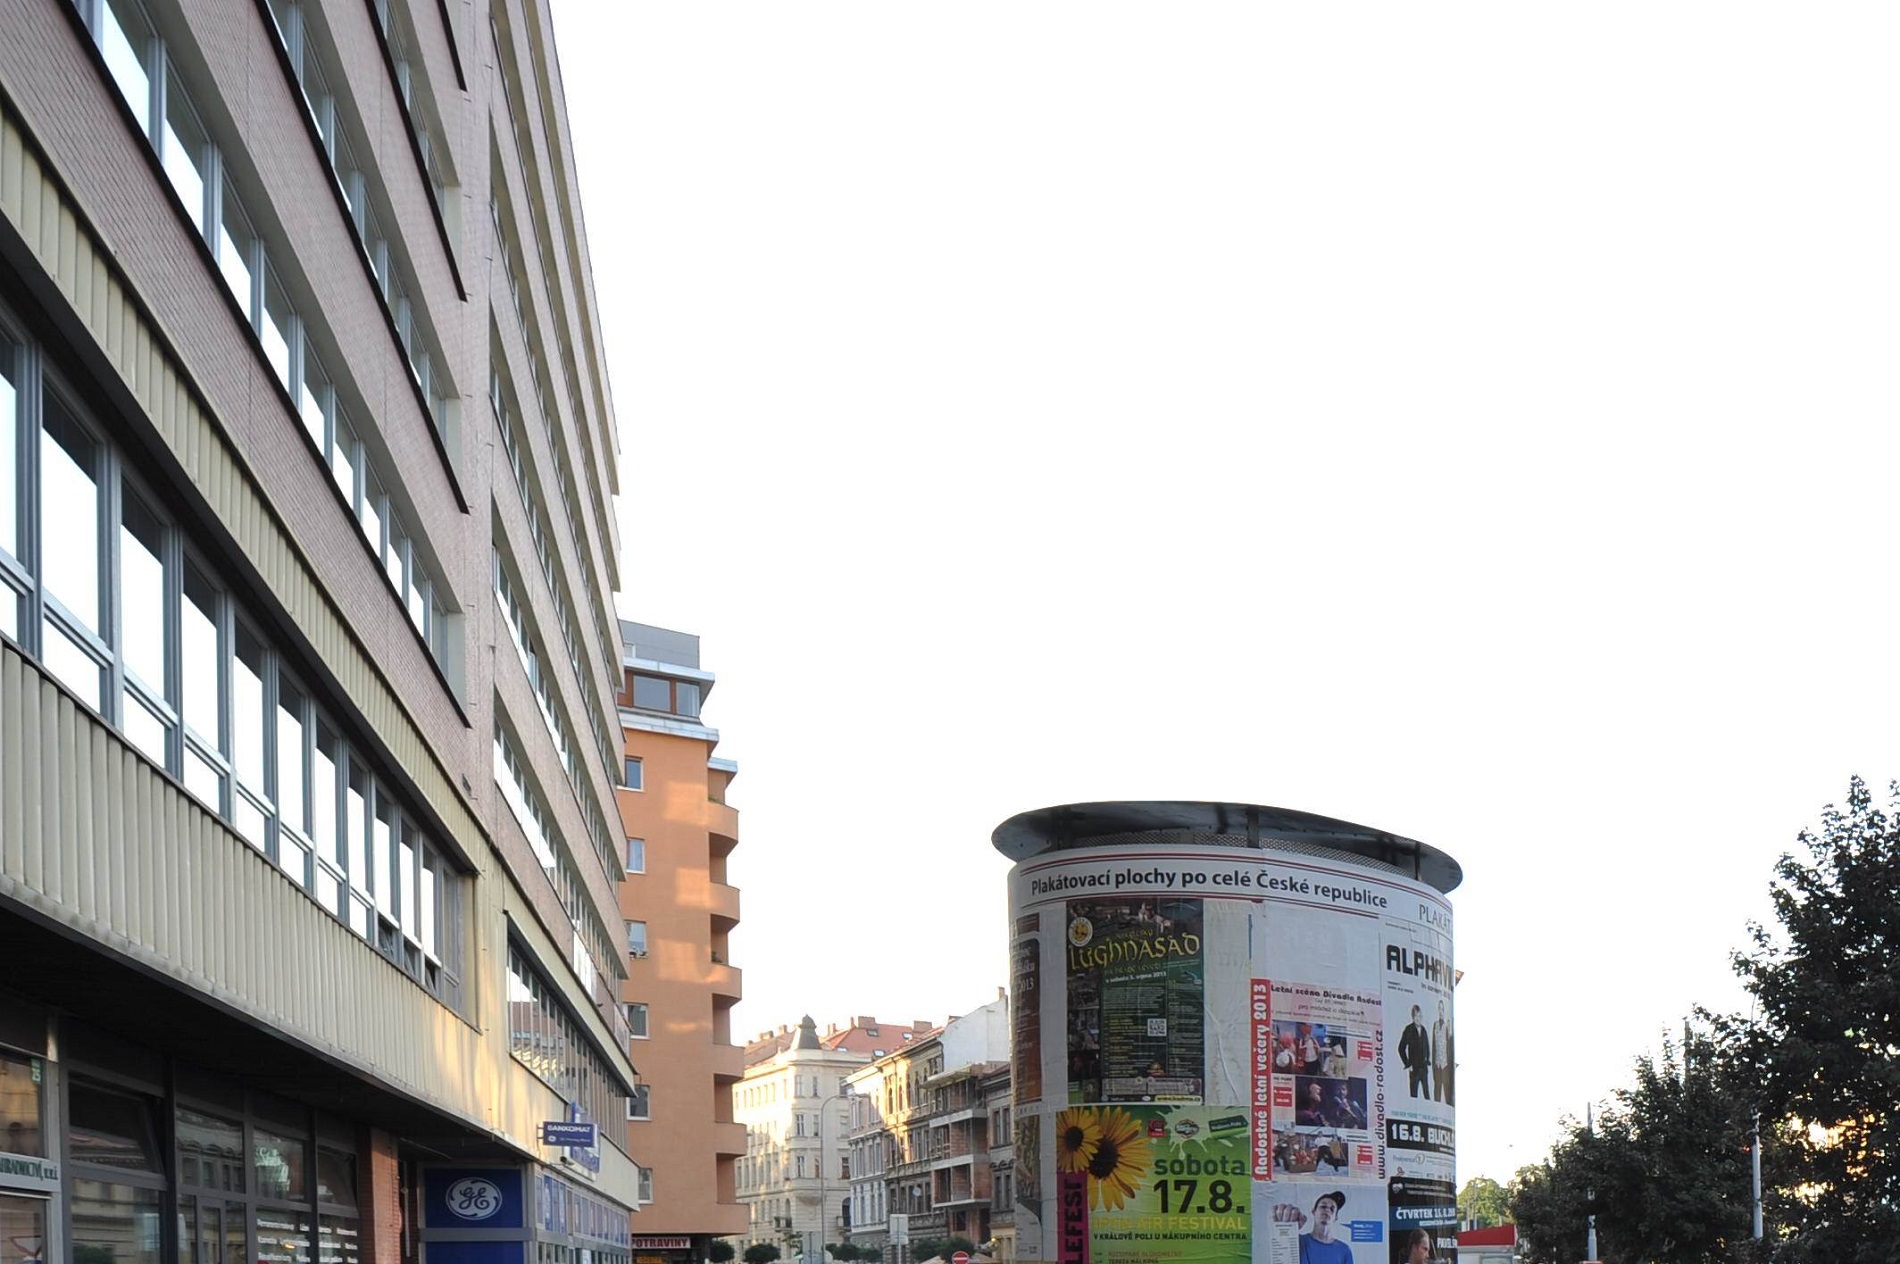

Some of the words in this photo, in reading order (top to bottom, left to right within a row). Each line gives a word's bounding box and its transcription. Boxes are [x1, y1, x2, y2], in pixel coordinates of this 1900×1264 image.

[1032, 869, 1111, 896] Plakátovací
[1115, 867, 1176, 889] plochy
[1181, 871, 1207, 888] po
[1212, 869, 1251, 887] celé
[1256, 870, 1310, 894] České
[1314, 883, 1388, 909] republice
[1253, 983, 1267, 1020] 2013
[1253, 1024, 1270, 1071] večery
[1254, 1074, 1268, 1107] letní
[1374, 1030, 1386, 1179] www.divadlo-radost.cz
[547, 1125, 591, 1133] BANKOMAT
[1254, 1110, 1268, 1175] Radostné
[1391, 1123, 1425, 1143] 16.8.
[1153, 1154, 1246, 1176] sobota
[1153, 1179, 1245, 1214] 17.8.
[1168, 1216, 1247, 1231] FESTIVAL
[1396, 1207, 1433, 1220] ČTVRTEK
[1134, 1232, 1153, 1241] POLI
[1154, 1232, 1162, 1240] U
[1162, 1231, 1212, 1241] NÁKUPNÍHO
[1213, 1232, 1248, 1241] CENTRA
